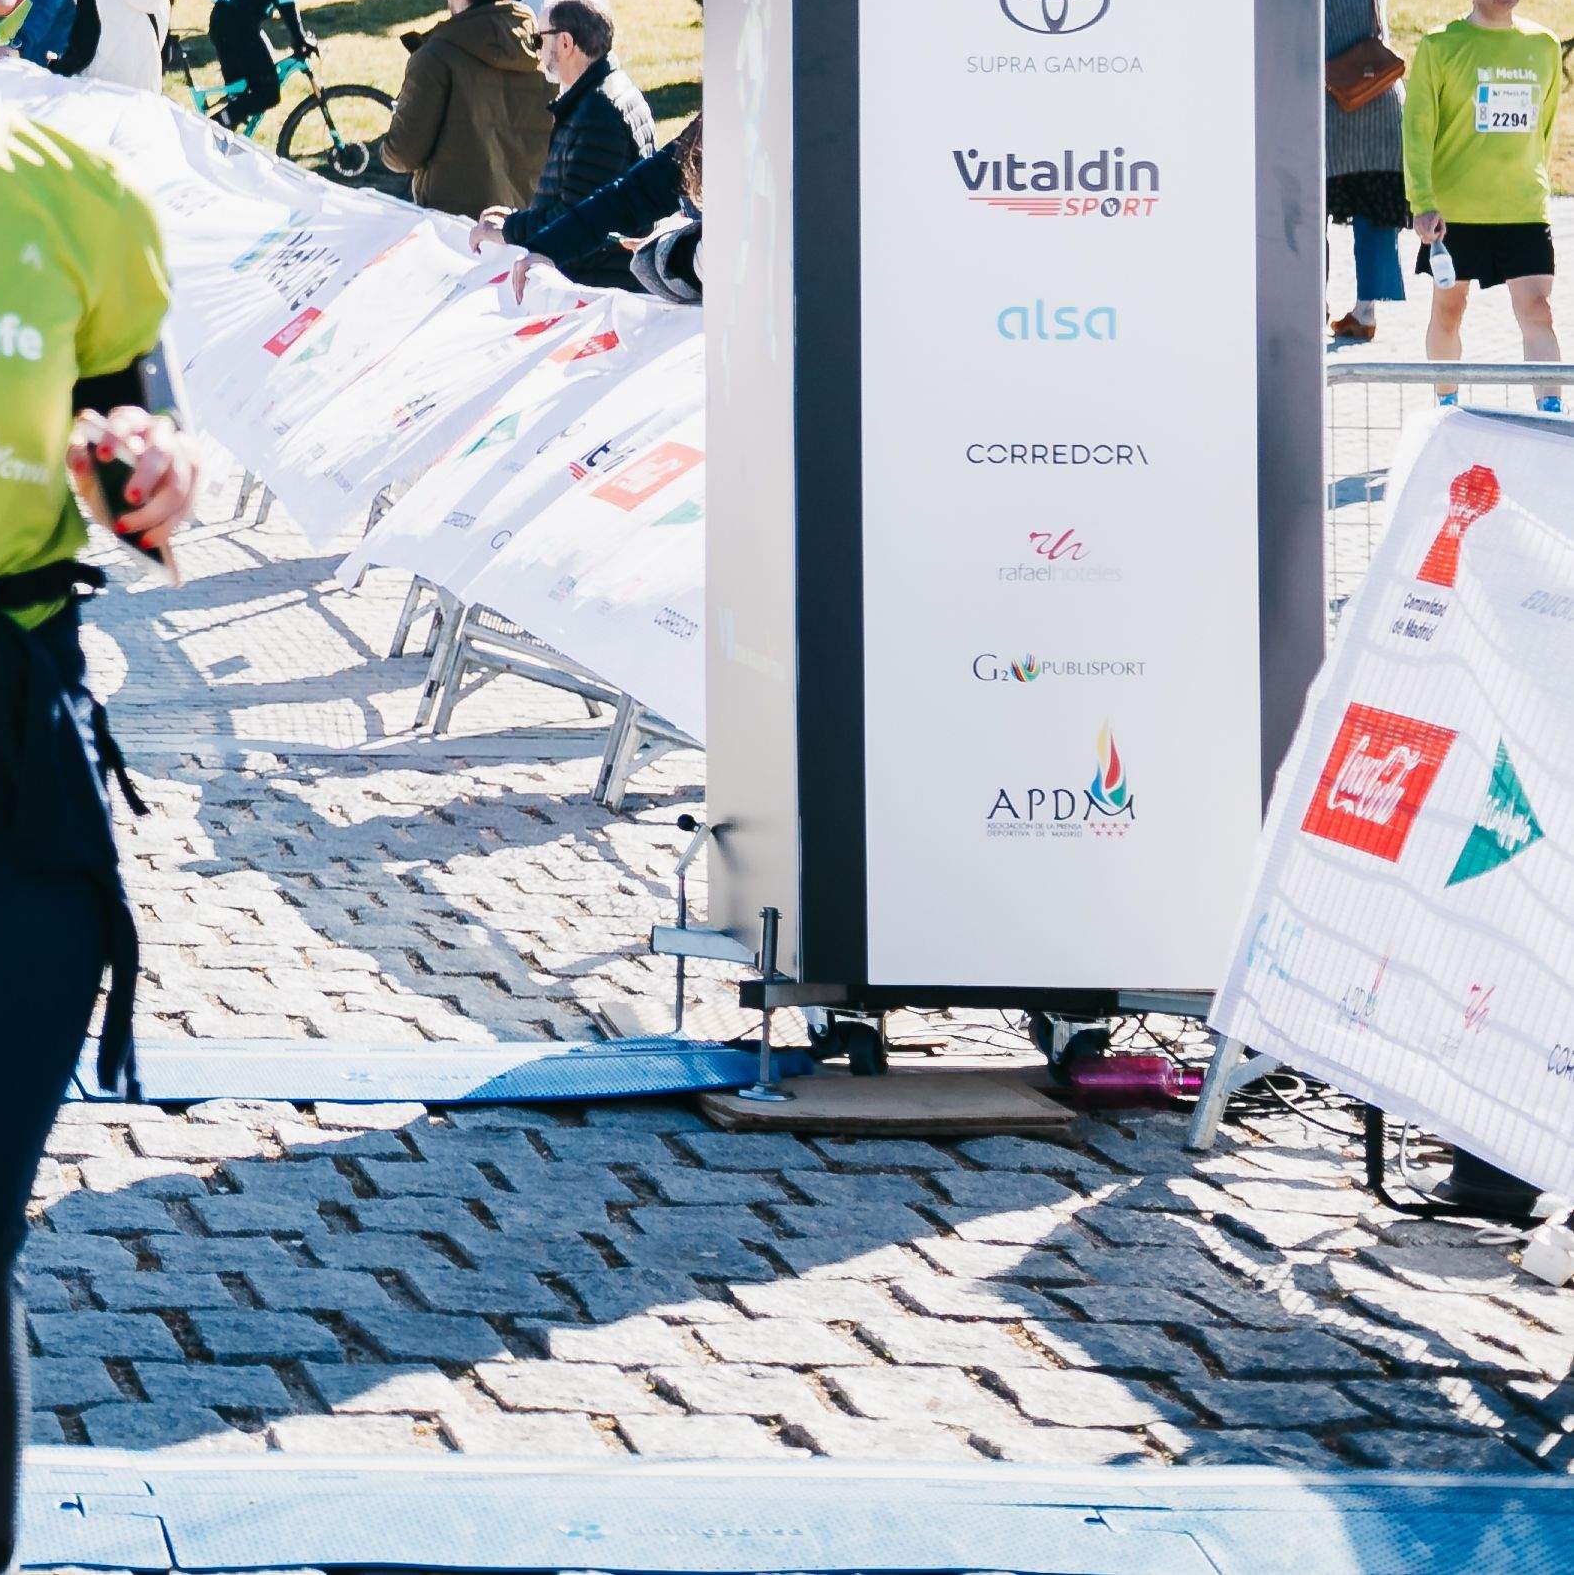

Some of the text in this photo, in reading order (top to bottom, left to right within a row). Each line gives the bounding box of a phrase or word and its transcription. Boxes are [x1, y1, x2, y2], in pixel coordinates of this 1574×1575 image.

[966, 55, 1144, 74] SUPRA GAMBOA
[1492, 112, 1528, 128] 2294
[952, 146, 1160, 192] Vitaldin
[1063, 196, 1159, 218] SPORT
[997, 299, 1117, 340] alsa
[1403, 592, 1450, 618] Comunidad
[1392, 617, 1439, 643] de Madrid
[1041, 660, 1147, 677] PUBLISPORT
